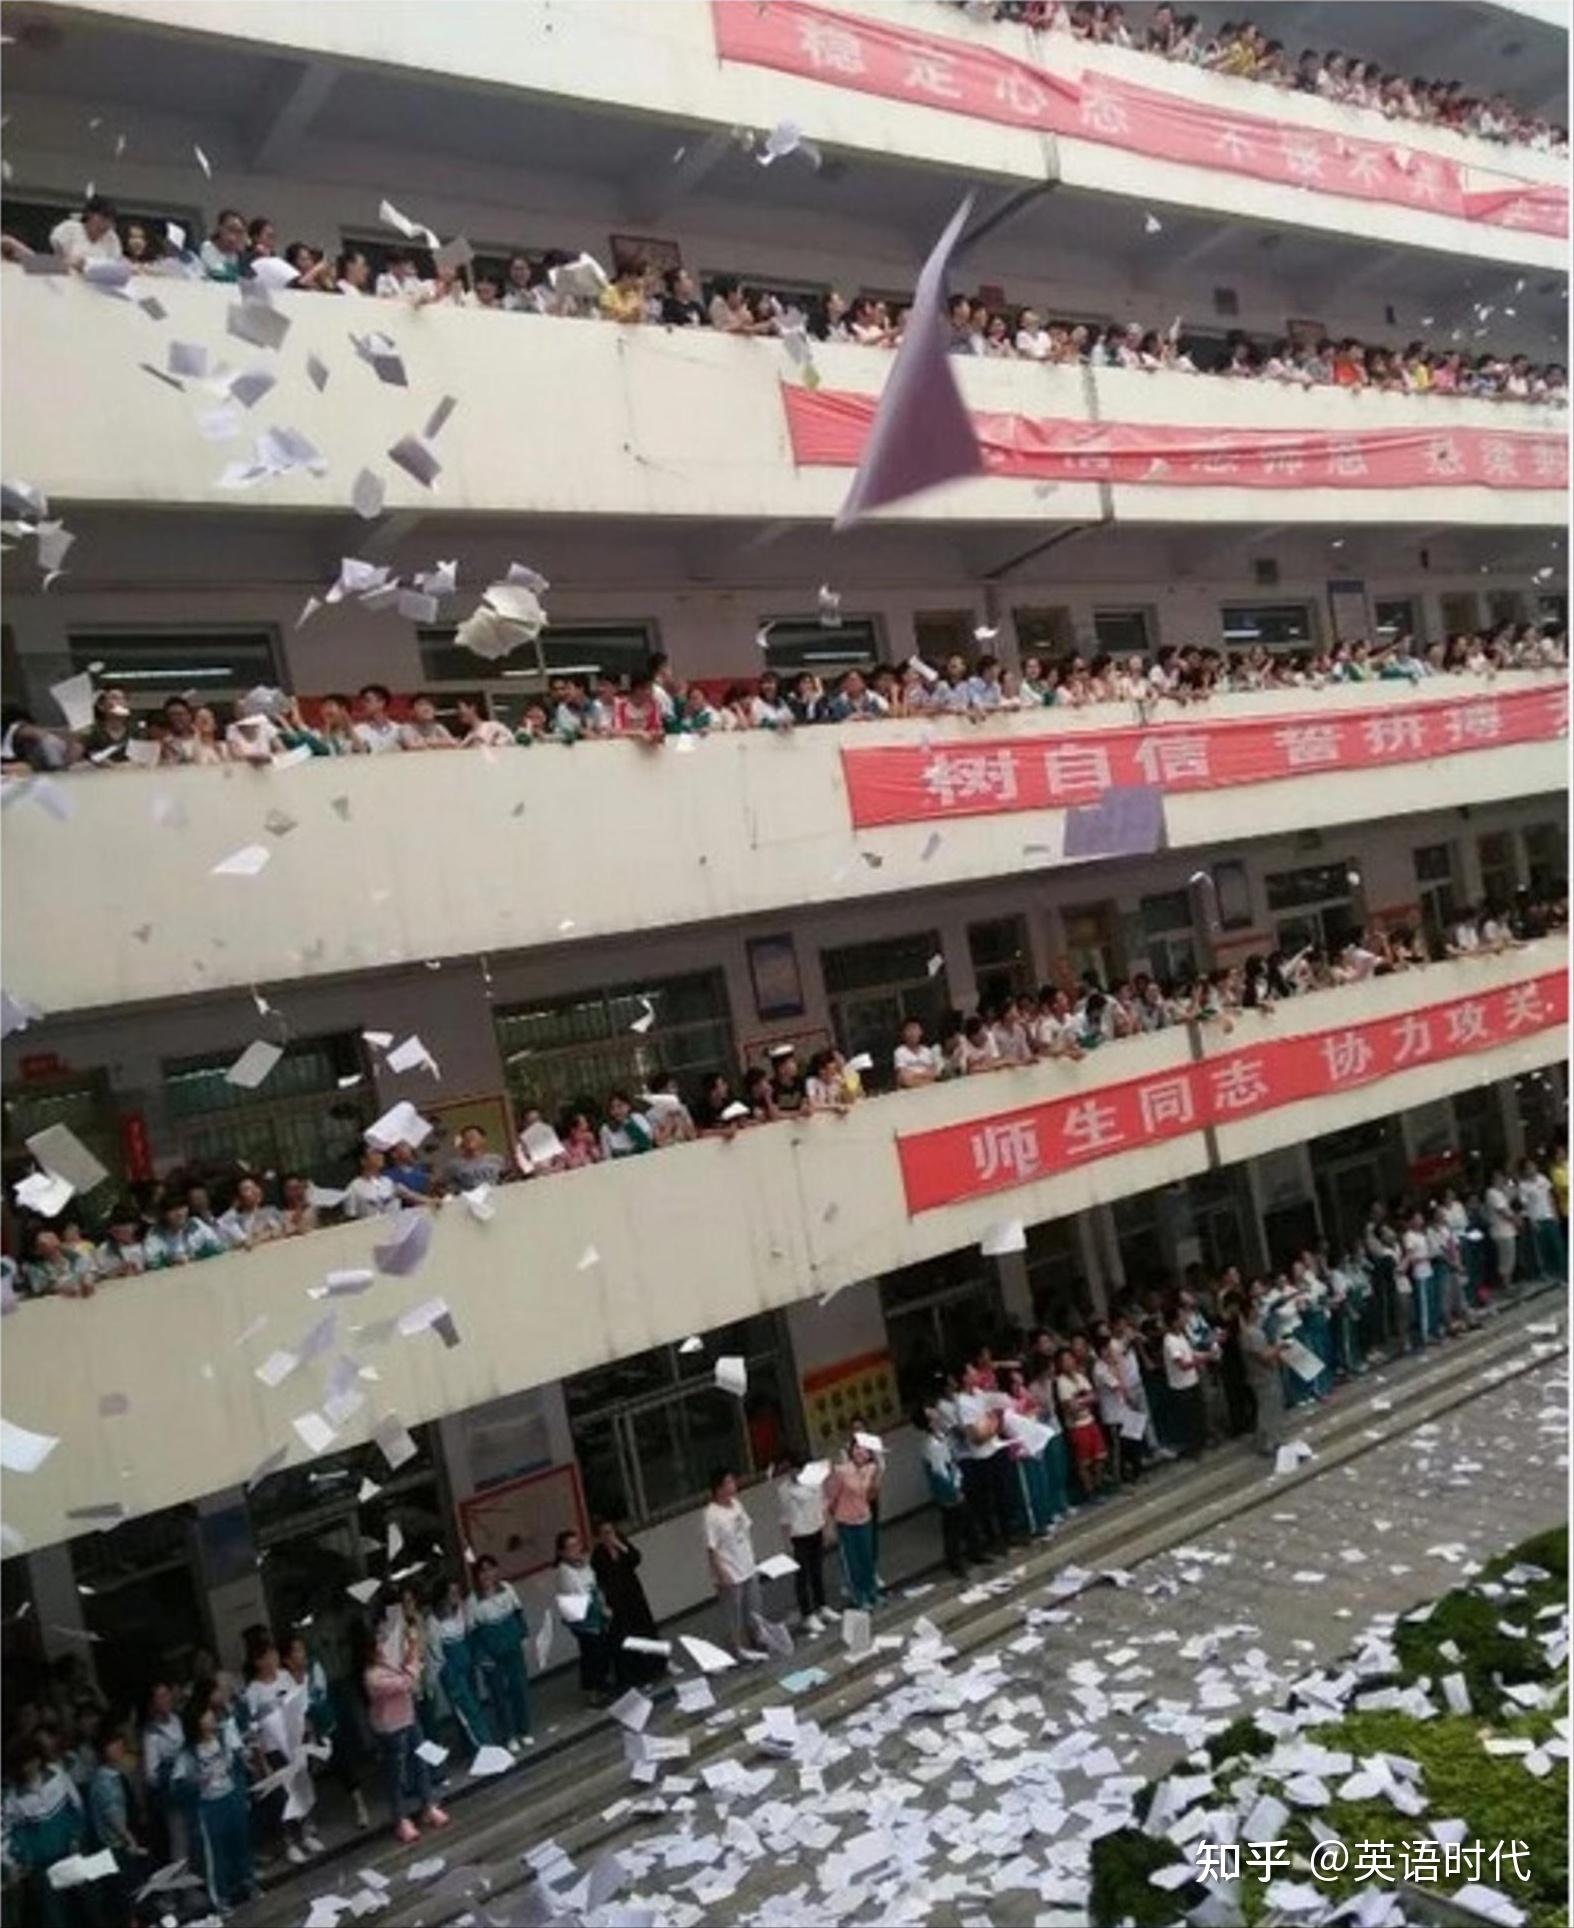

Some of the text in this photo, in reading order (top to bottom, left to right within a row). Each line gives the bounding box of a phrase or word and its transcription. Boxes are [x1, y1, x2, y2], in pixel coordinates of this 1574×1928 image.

[801, 17, 1129, 133] 稳定心态
[920, 733, 1211, 806] 树自信
[1273, 699, 1502, 766] 誓拼搏
[970, 980, 1545, 1180] 师生同志 协力攻关
